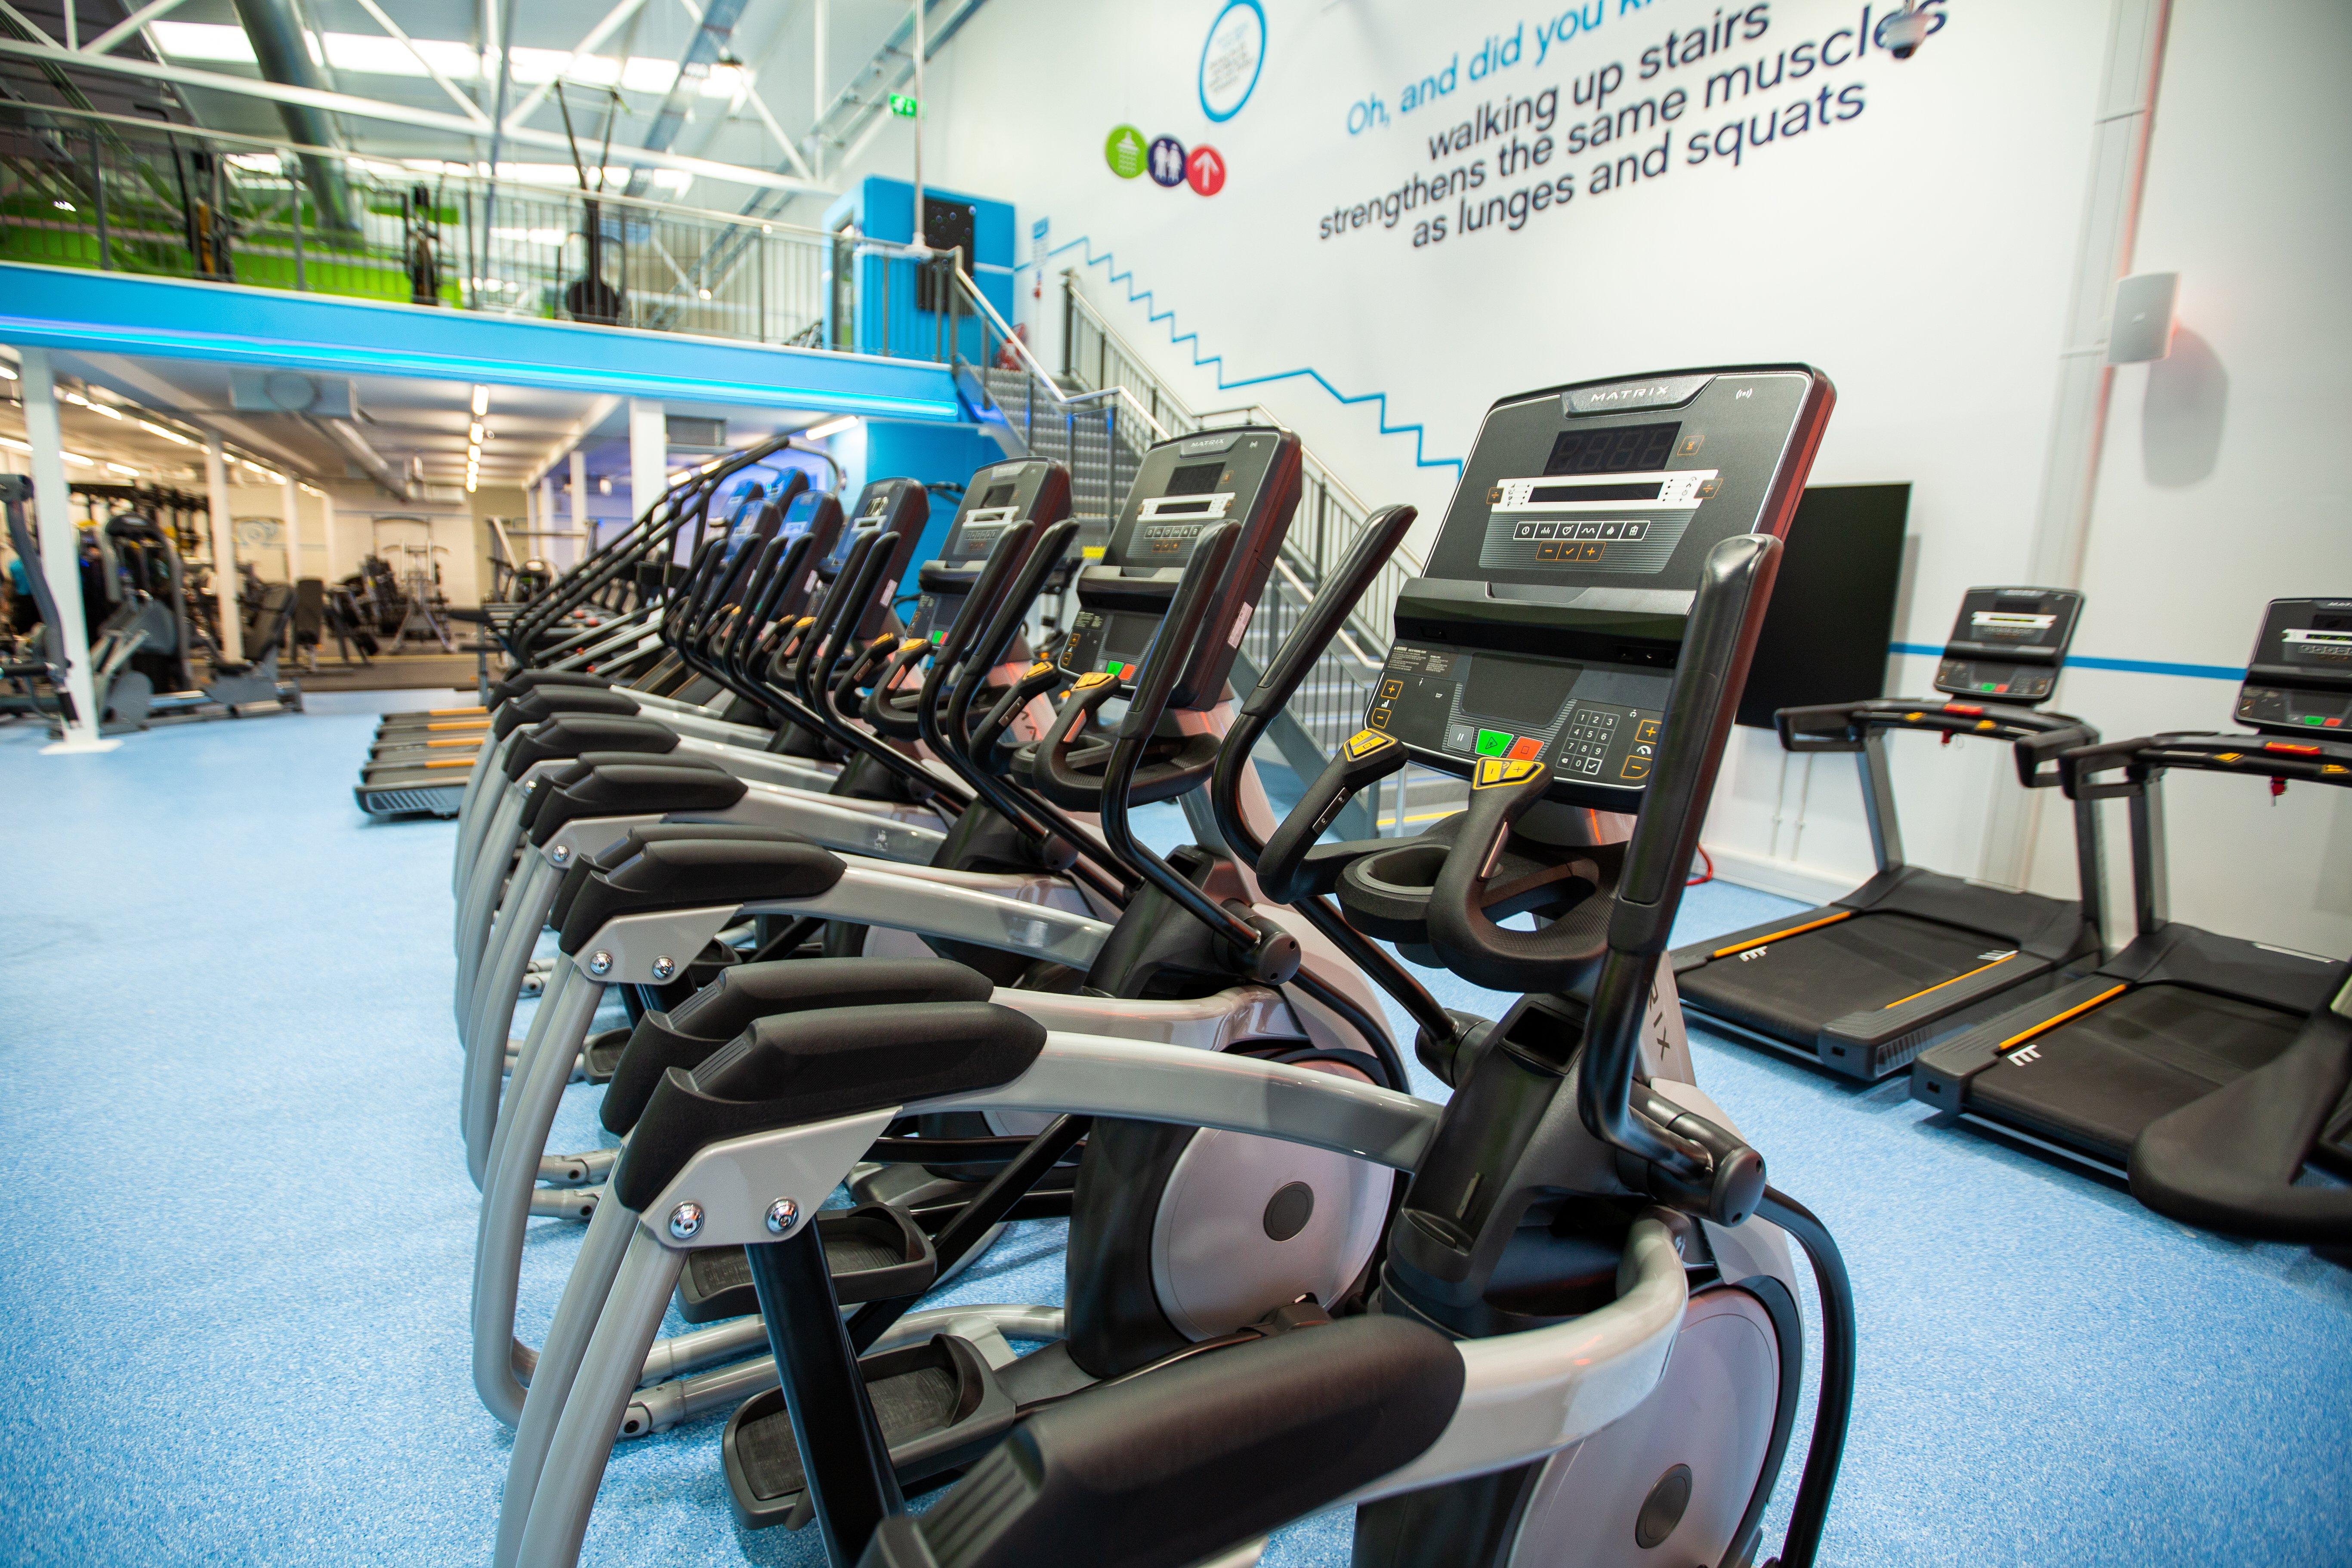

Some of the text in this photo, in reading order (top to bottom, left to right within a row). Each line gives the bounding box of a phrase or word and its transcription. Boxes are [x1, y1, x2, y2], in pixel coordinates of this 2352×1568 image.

[1347, 0, 1604, 136] Oh, and did you
[1429, 1, 1770, 161] walking up stairs
[1320, 159, 1485, 241] strengthens
[1499, 134, 1554, 177] the
[1568, 87, 1687, 155] same
[1413, 83, 1866, 248] as lunges and squats
[1191, 438, 1225, 448] MATRIX
[1590, 385, 1670, 402] MATRIX
